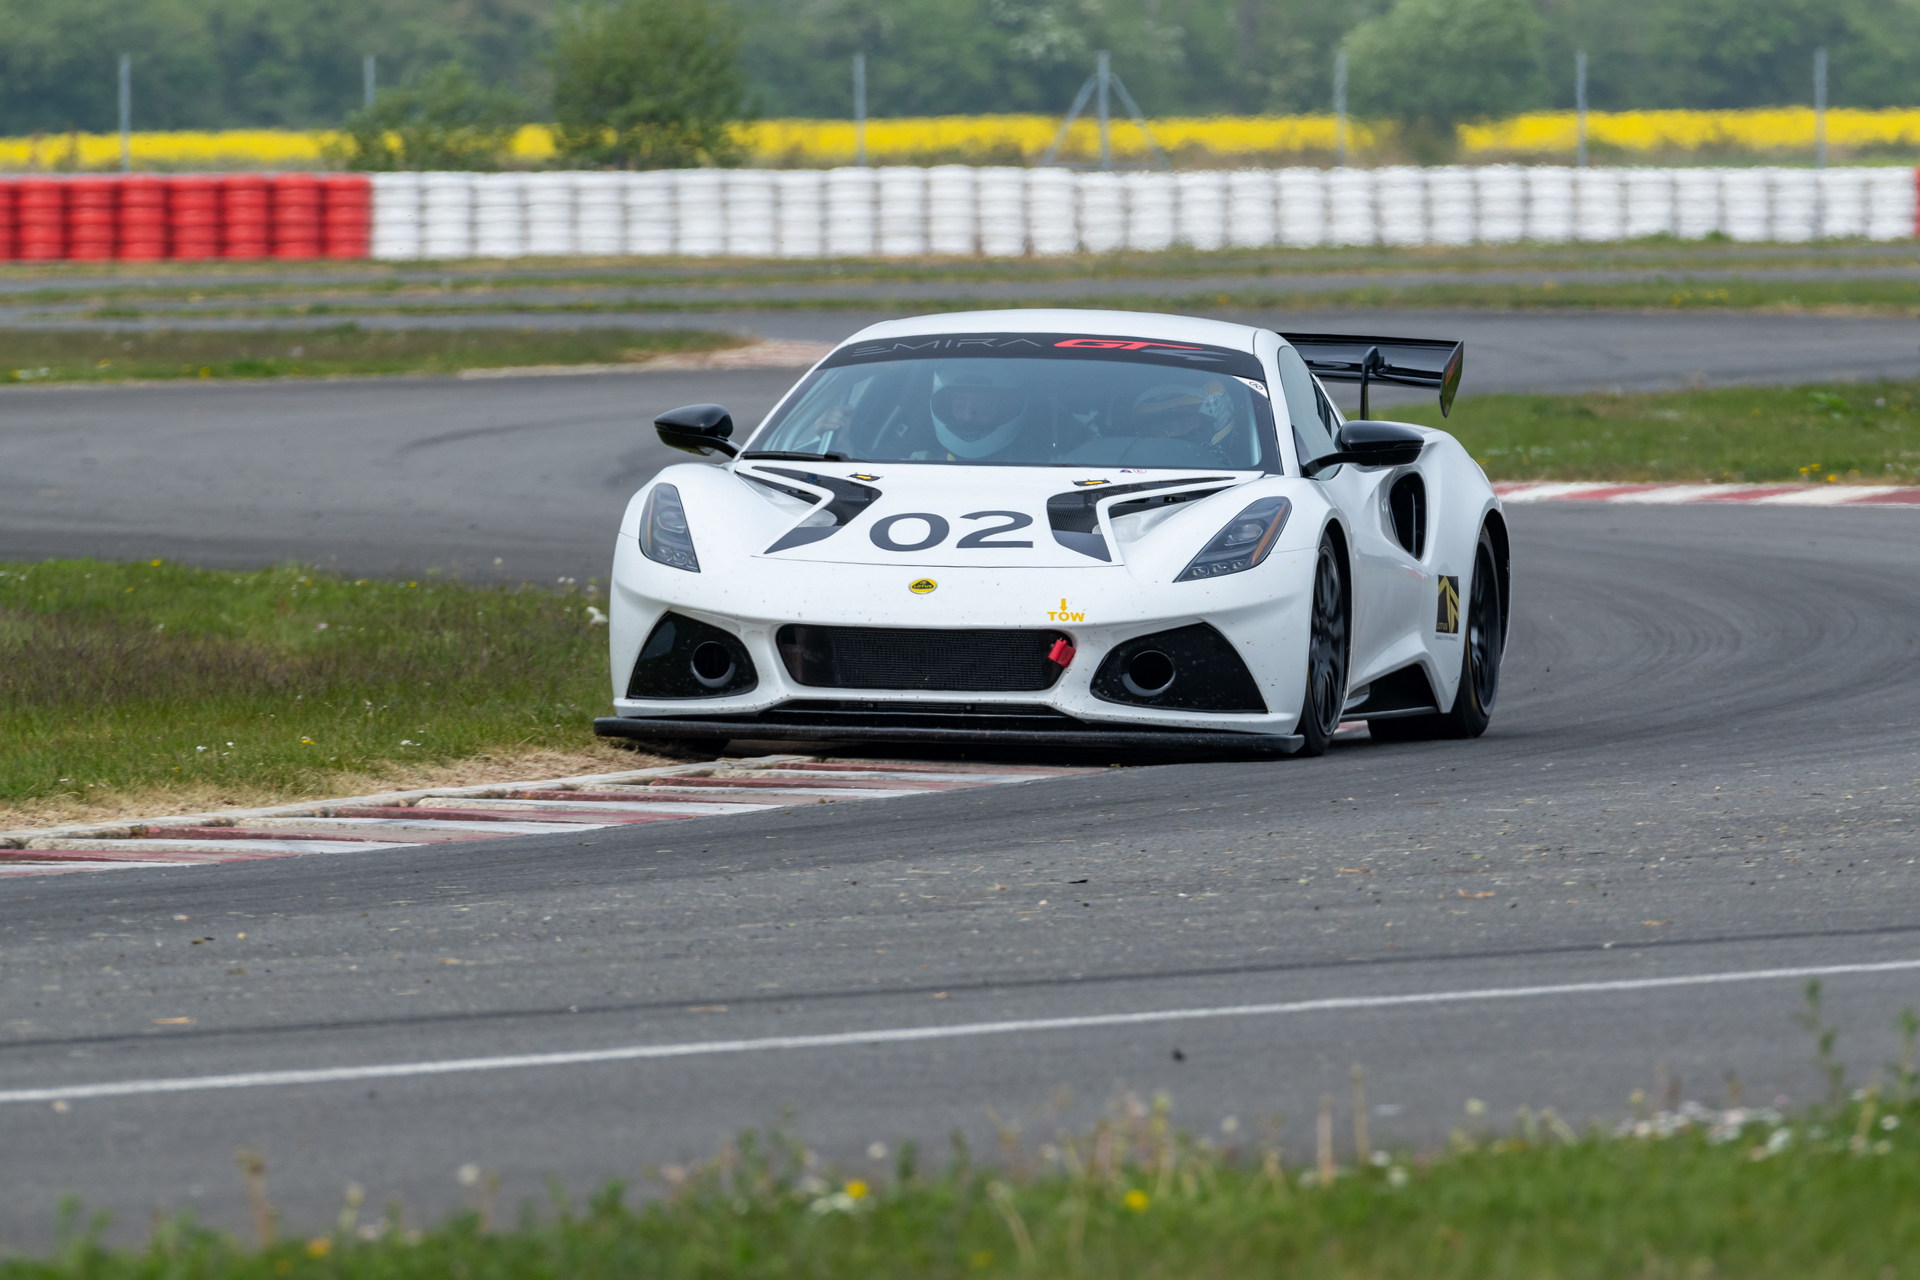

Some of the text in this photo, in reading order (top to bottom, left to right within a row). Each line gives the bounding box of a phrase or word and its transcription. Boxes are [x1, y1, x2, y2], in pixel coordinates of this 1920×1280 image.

[852, 338, 1042, 357] EMIRA
[869, 510, 1034, 552] 02
[1046, 611, 1085, 622] TOW
